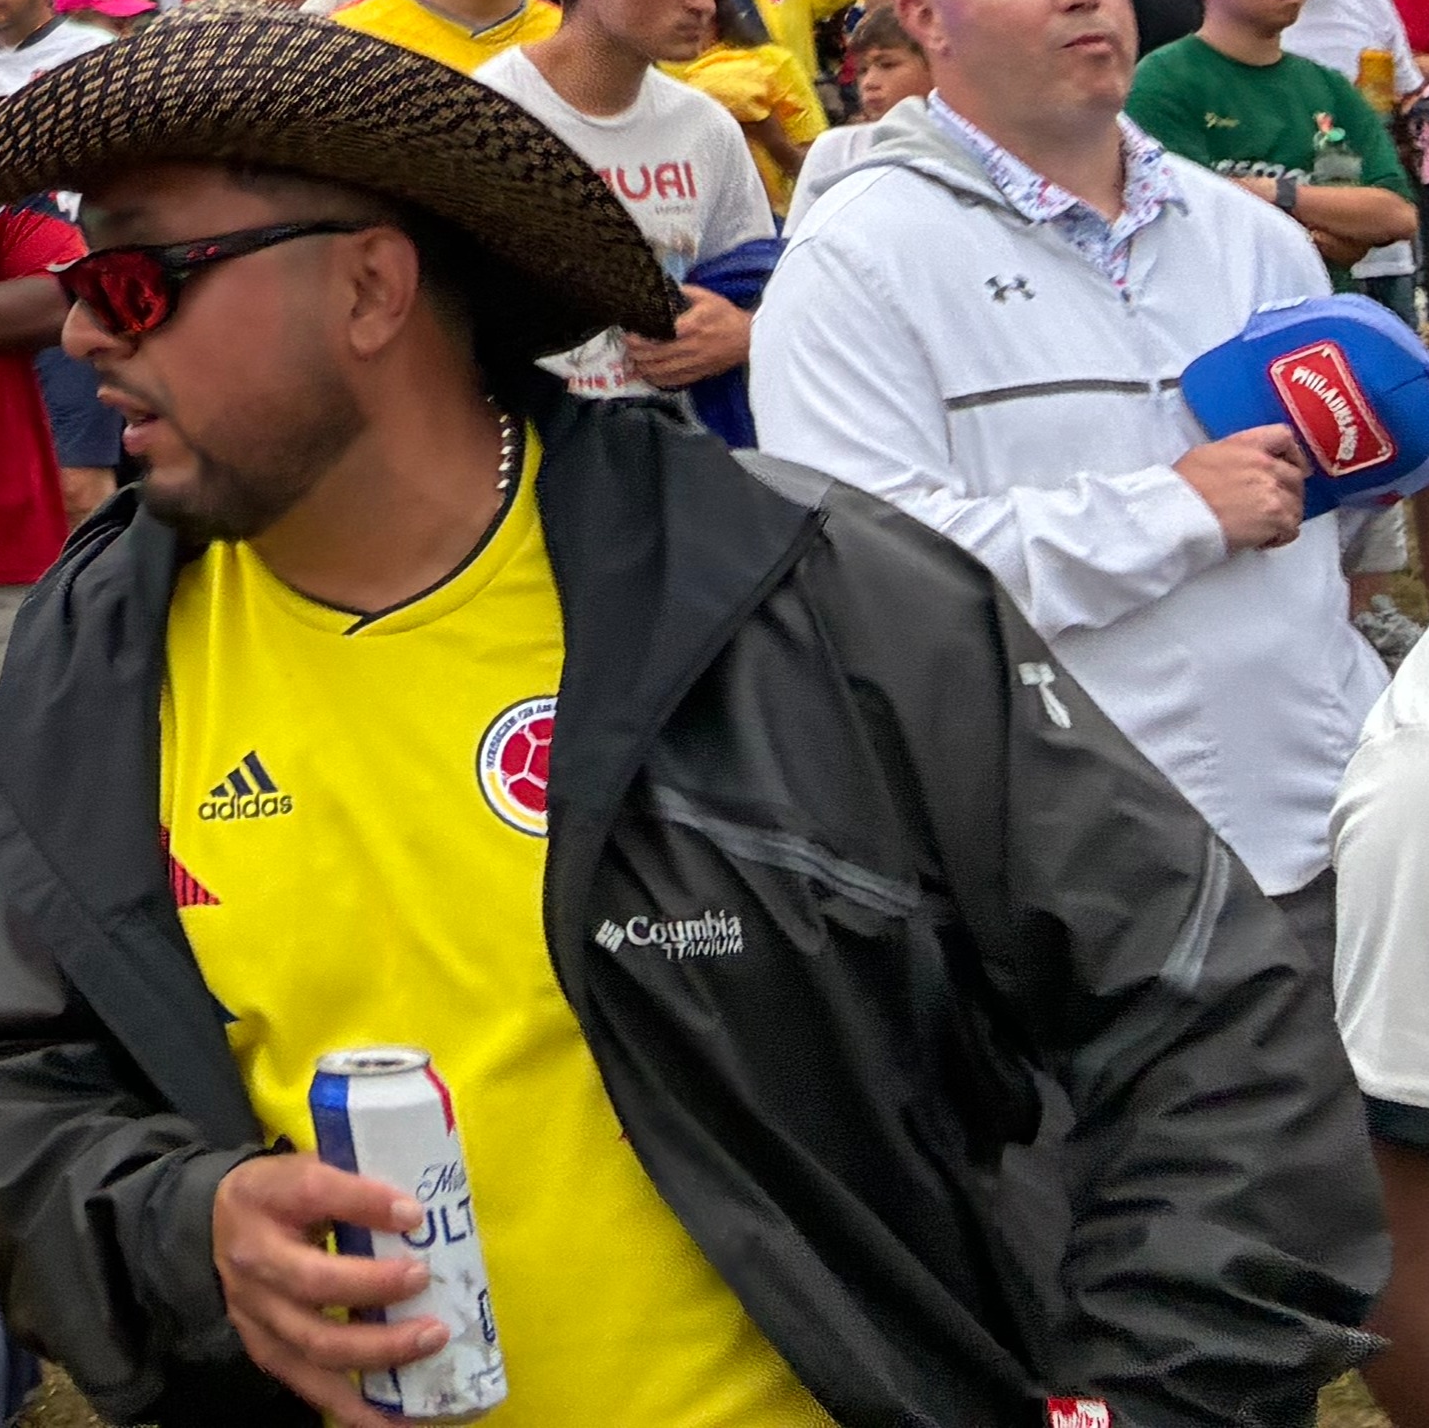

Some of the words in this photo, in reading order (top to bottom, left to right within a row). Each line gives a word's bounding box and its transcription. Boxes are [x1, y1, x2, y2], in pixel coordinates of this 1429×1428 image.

[198, 789, 293, 821] adidas
[626, 909, 742, 946] Coumbia
[401, 1192, 475, 1249] ULT
